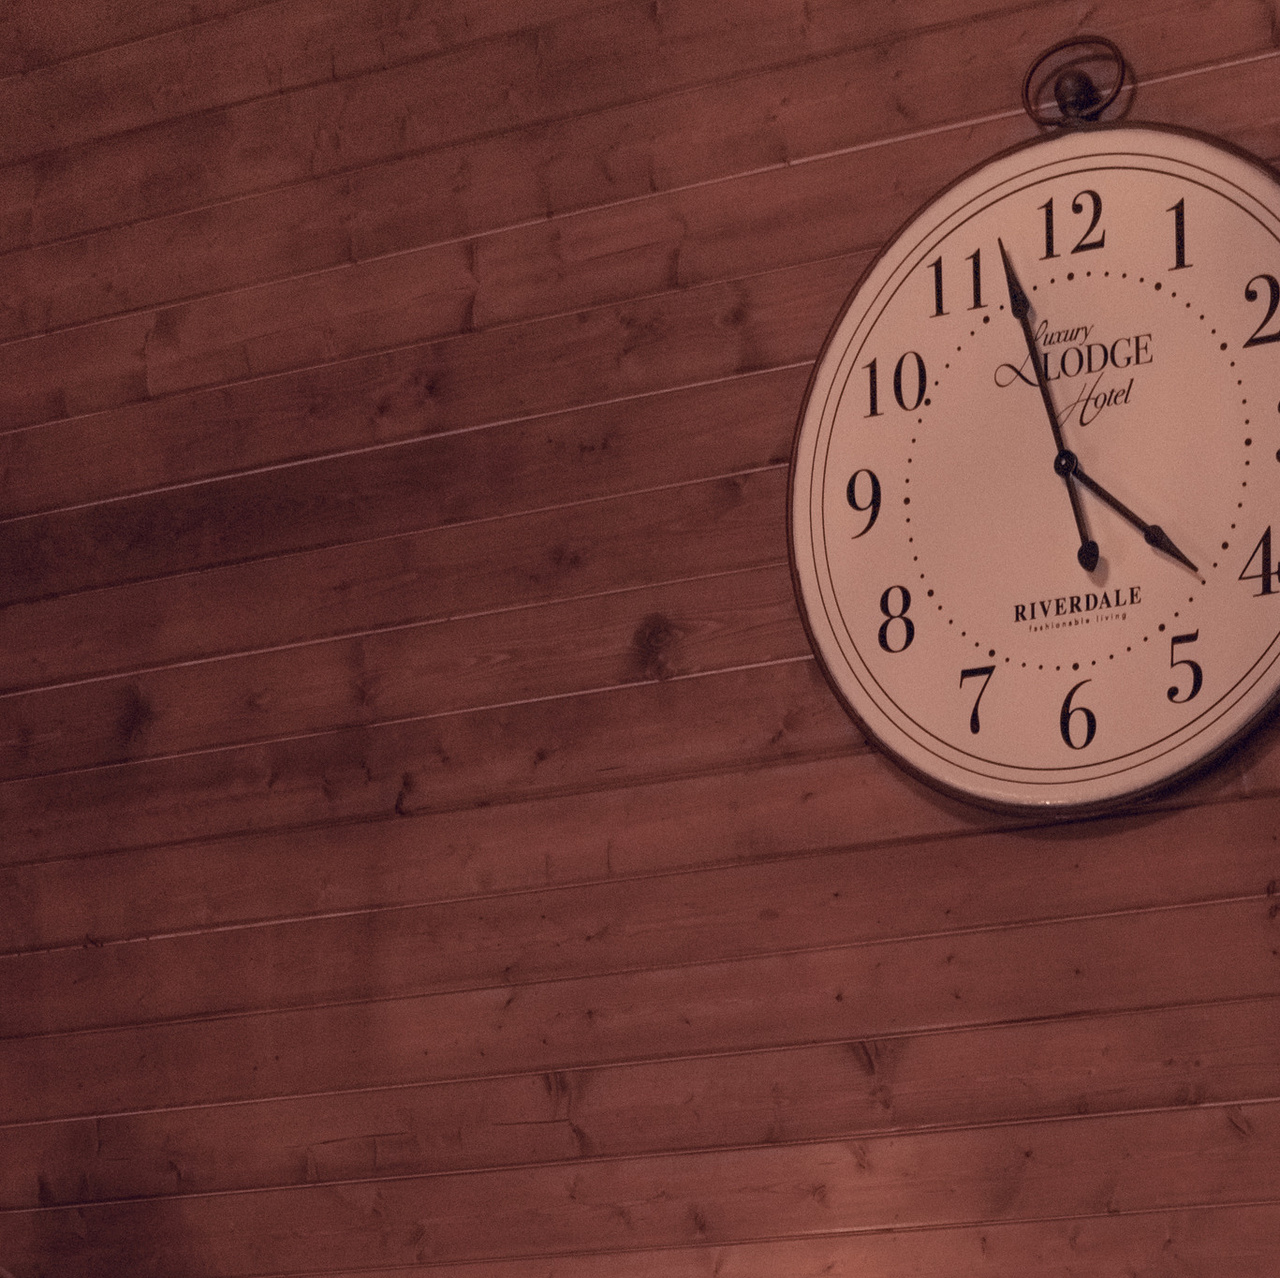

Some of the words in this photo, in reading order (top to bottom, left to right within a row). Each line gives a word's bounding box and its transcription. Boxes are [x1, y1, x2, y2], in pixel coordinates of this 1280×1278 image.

[1037, 189, 1106, 260] 12
[1165, 197, 1194, 272] 1
[926, 247, 989, 318] 11
[861, 351, 927, 418] 10
[1043, 333, 1154, 382] LODGE
[1056, 371, 1135, 427] Hotel
[846, 468, 882, 539] 9
[877, 585, 915, 653] 8
[1014, 586, 1142, 623] RIVERDALE
[1029, 617, 1090, 632] fashionable
[1096, 612, 1127, 623] living
[958, 665, 996, 735] 7
[1166, 628, 1203, 703] 5
[1059, 679, 1097, 750] 6
